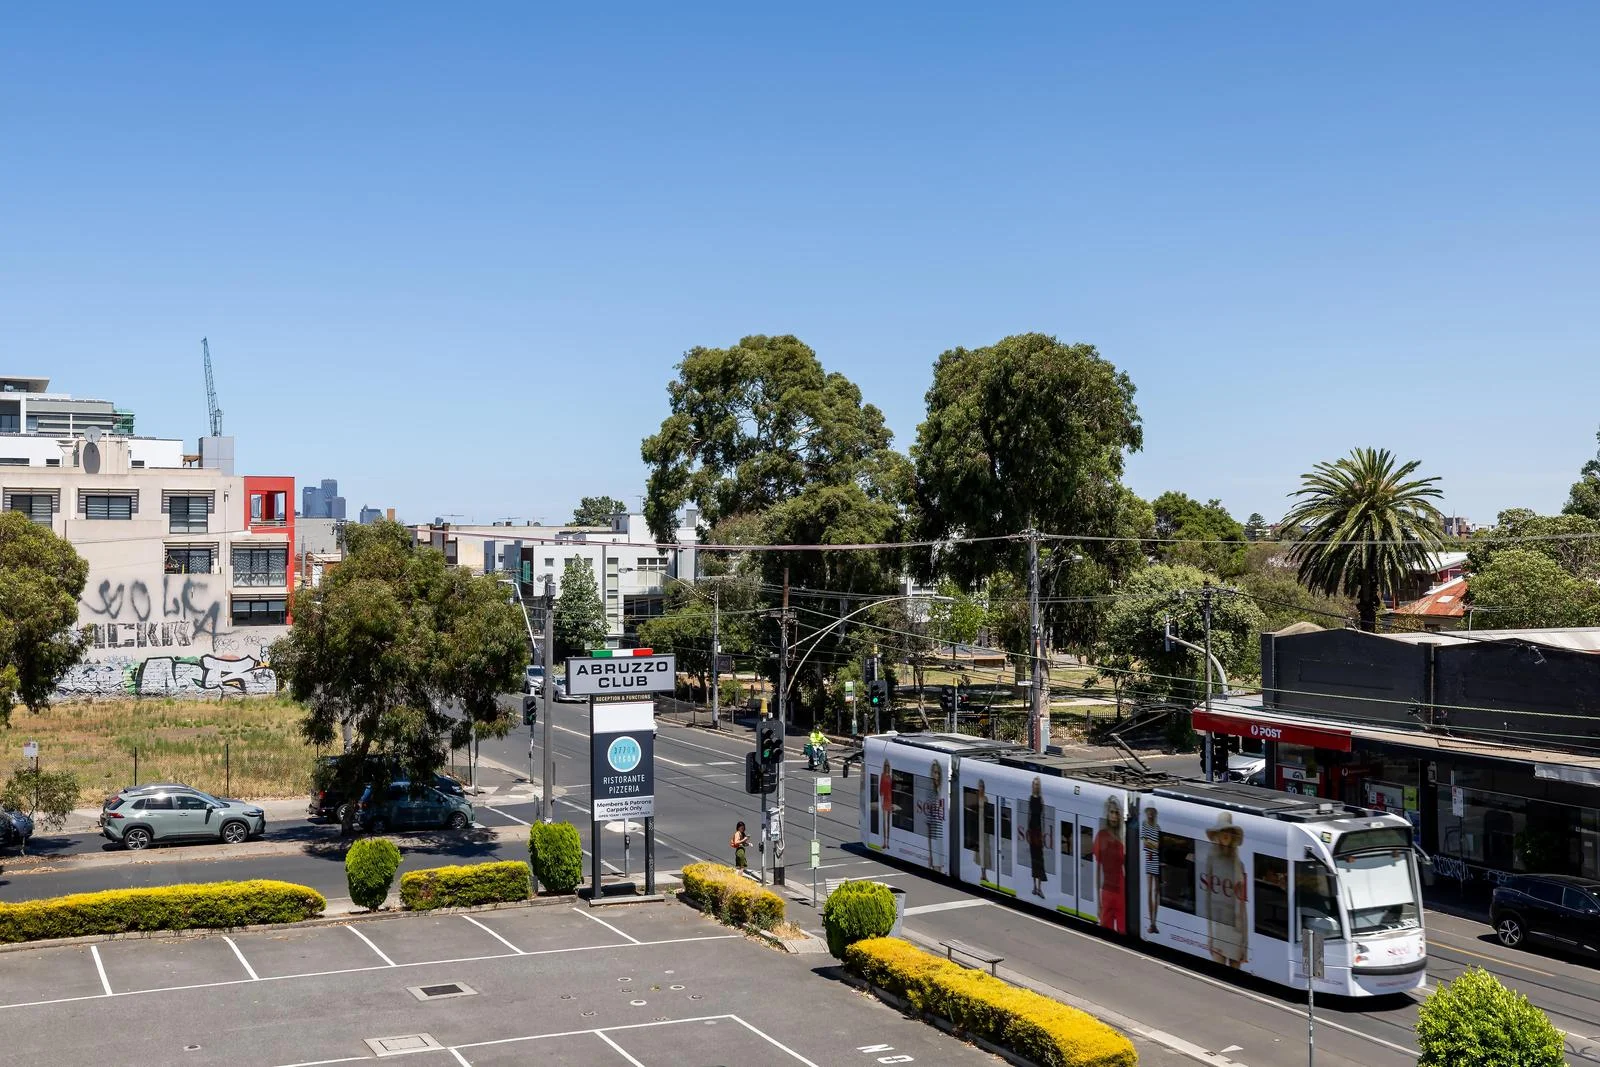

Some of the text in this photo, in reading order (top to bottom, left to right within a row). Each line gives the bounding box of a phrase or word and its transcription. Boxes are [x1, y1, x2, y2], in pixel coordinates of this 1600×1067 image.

[577, 661, 668, 675] ABRUZZO
[598, 676, 648, 688] CLUB
[1260, 727, 1282, 738] POST
[603, 774, 646, 785] RISTORANTE
[609, 785, 640, 795] PIZZERIA
[1199, 872, 1248, 902] seed
